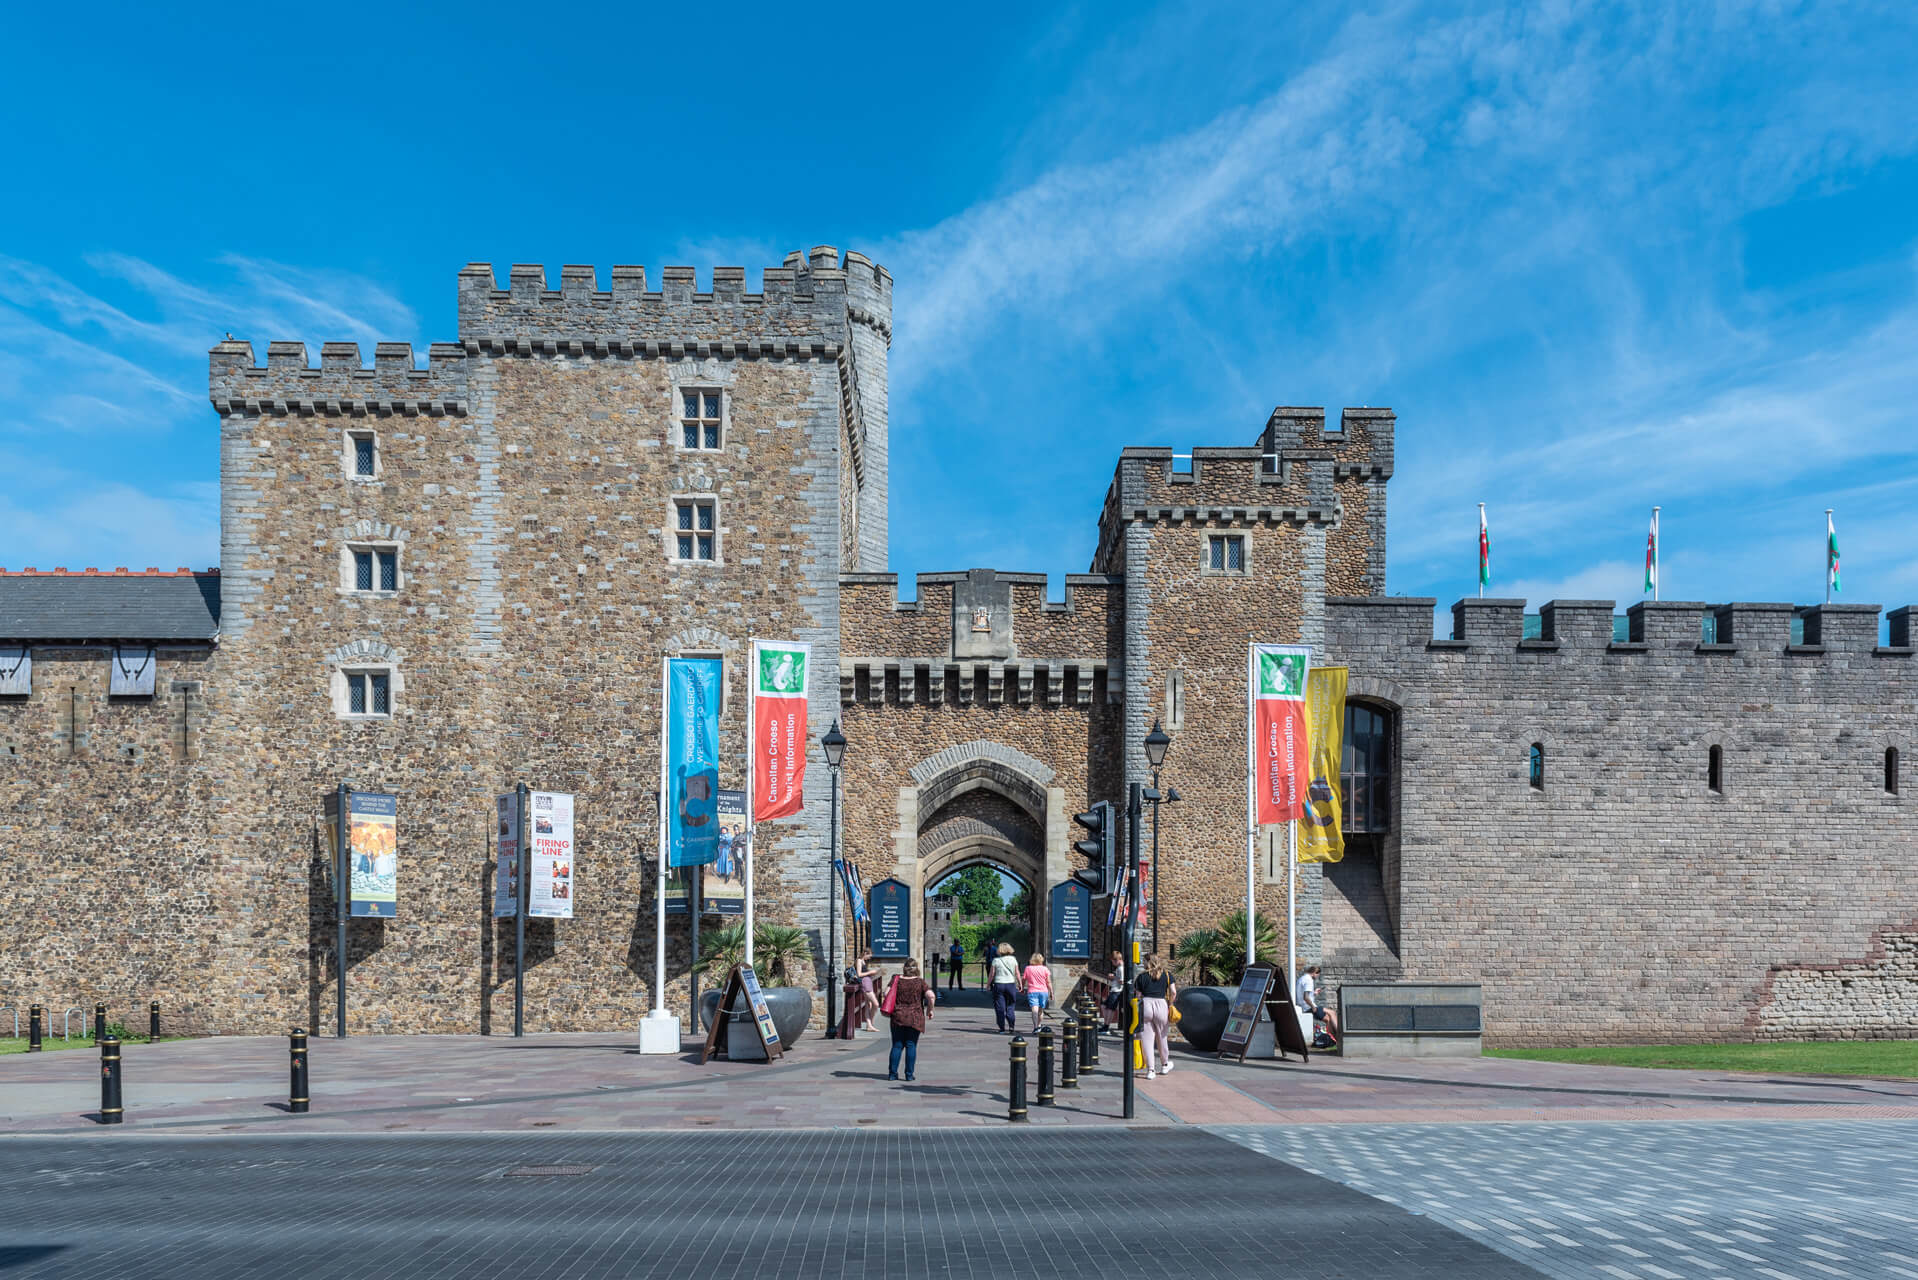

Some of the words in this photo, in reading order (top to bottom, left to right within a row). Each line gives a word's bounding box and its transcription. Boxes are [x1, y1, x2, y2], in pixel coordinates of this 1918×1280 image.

[686, 725, 695, 763] CROESO
[696, 720, 704, 763] WELCOME
[768, 719, 778, 755] Croeso
[784, 713, 795, 770] Information
[1269, 721, 1278, 758] Croeso
[1284, 715, 1295, 771] Information
[768, 758, 778, 803] Canolfan
[1269, 760, 1281, 805] Canolfan
[1287, 772, 1296, 807] Tourist
[536, 838, 569, 849] FIRING
[542, 847, 563, 856] LINE
